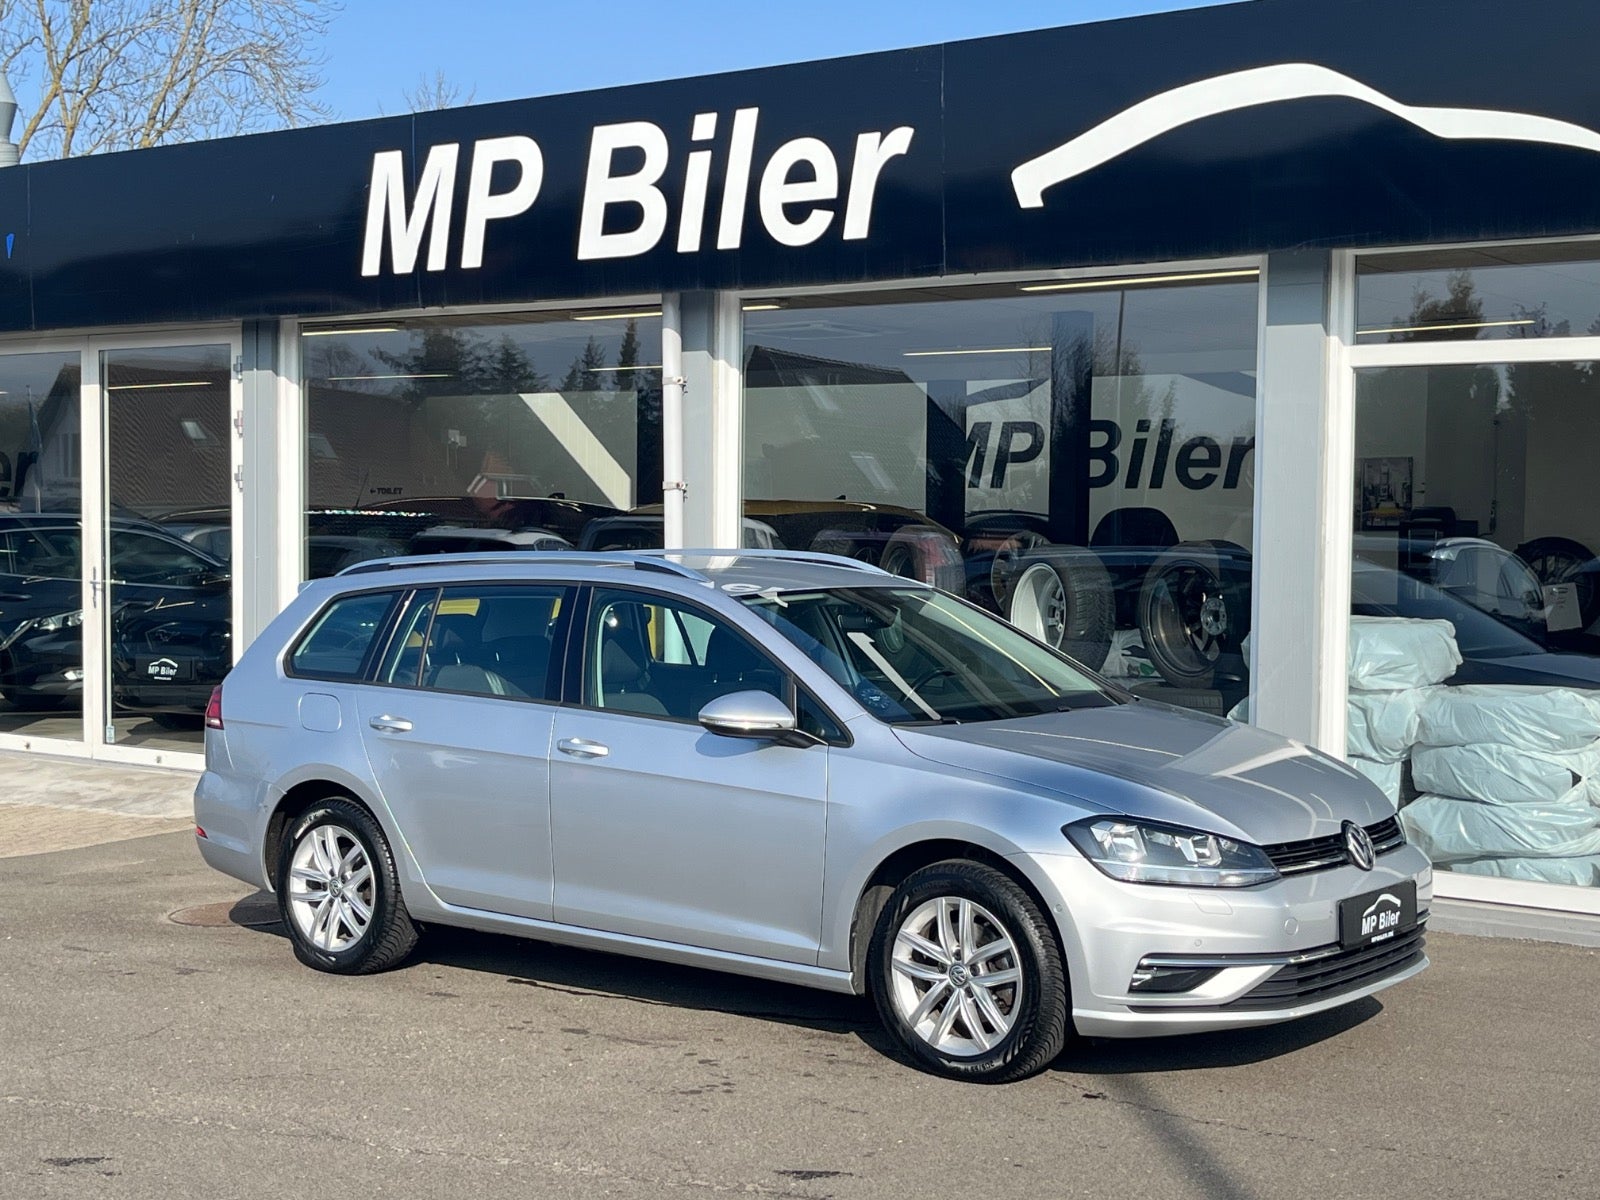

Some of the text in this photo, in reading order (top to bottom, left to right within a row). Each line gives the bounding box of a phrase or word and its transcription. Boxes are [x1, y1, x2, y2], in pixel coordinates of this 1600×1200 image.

[361, 106, 915, 276] MP Biler
[377, 487, 403, 495] TOILET
[147, 665, 177, 676] MP Biler
[1361, 910, 1400, 936] MP Biler
